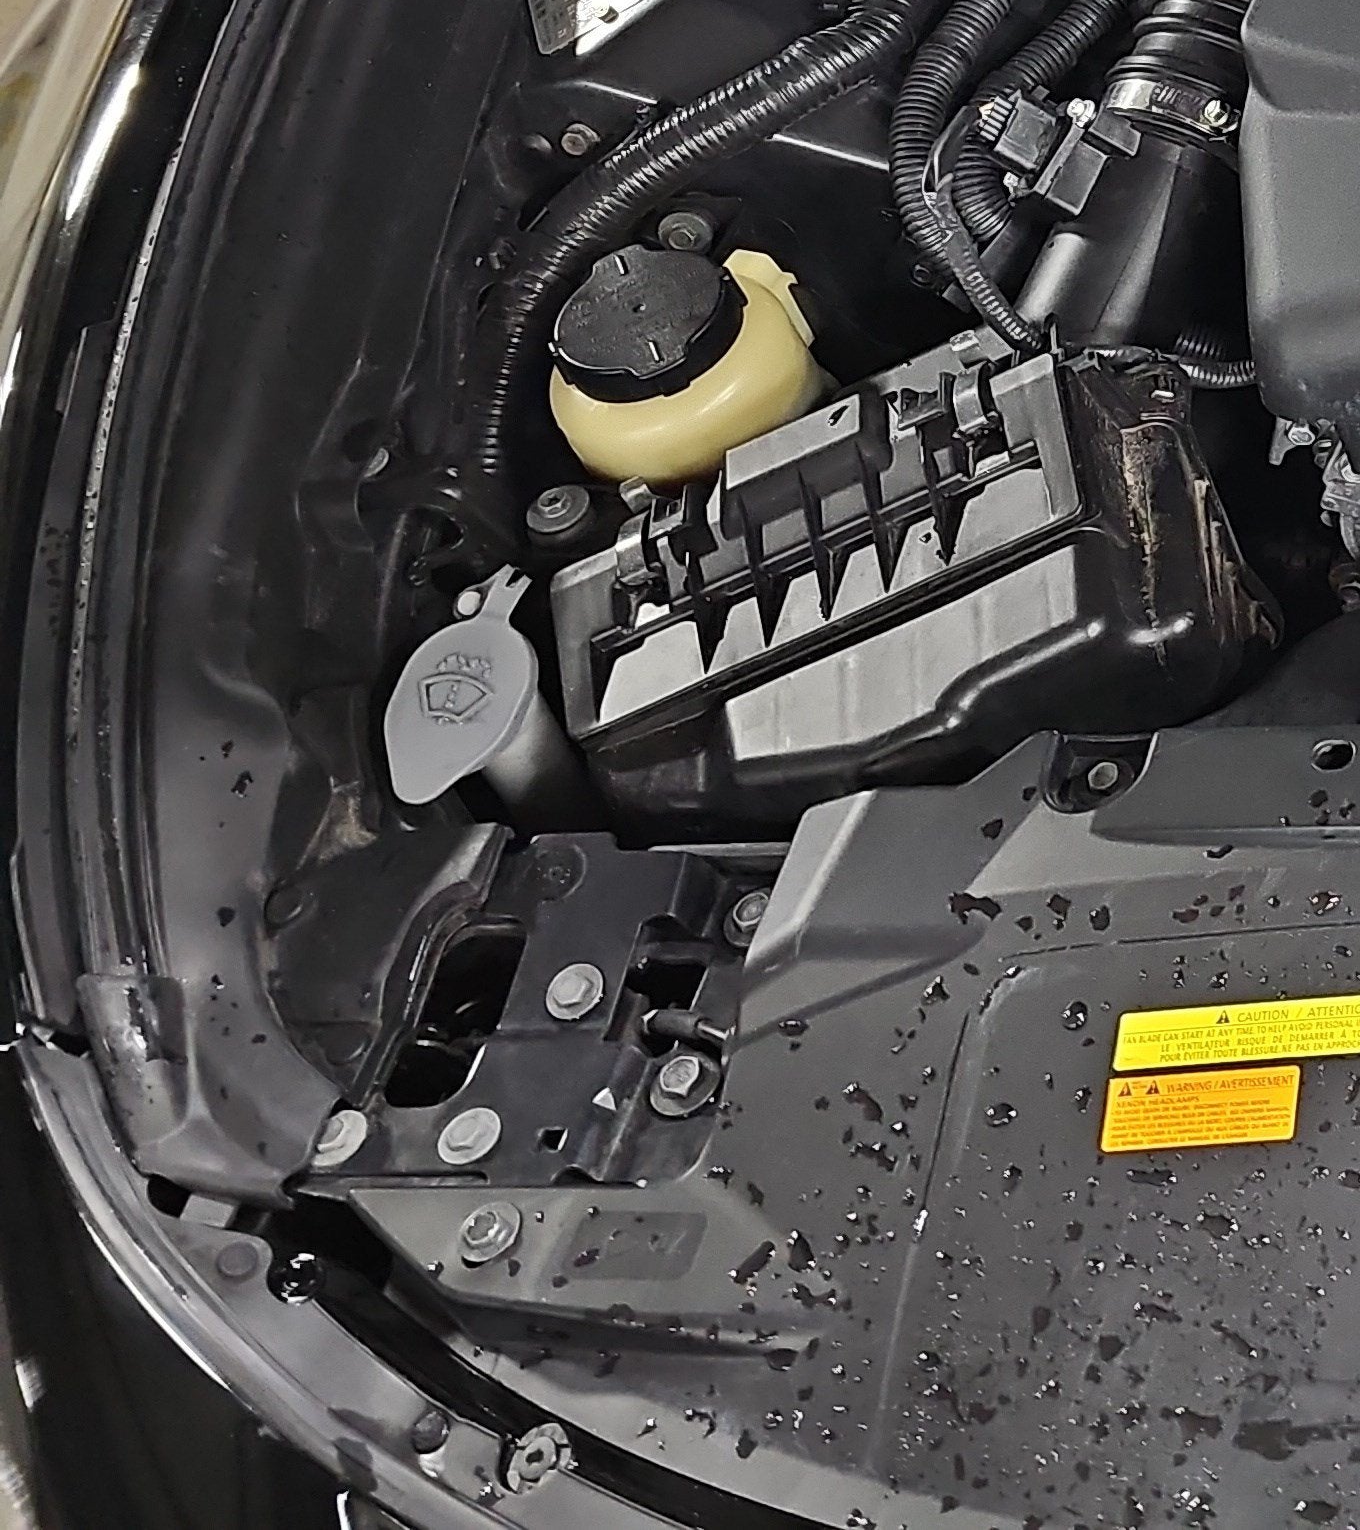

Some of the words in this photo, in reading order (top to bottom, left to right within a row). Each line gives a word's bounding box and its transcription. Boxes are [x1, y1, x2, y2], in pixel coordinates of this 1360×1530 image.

[1238, 1009, 1289, 1022] CAUTION
[1163, 1032, 1179, 1041] CAN
[1181, 1031, 1204, 1040] START
[1206, 1030, 1215, 1038] AT
[1217, 1029, 1233, 1037] ANY
[1257, 1026, 1267, 1034] TO
[1268, 1024, 1287, 1033] HELP
[1288, 1022, 1313, 1031] AVOID
[1316, 1020, 1353, 1030] PERSONAL
[1160, 1052, 1180, 1062] POUR
[1213, 1048, 1238, 1058] TOUTE
[1295, 1043, 1310, 1052] PAS
[1313, 1042, 1323, 1051] EN
[1161, 1044, 1170, 1053] LE
[1177, 1039, 1230, 1051] VENTILATEUR
[1237, 1037, 1266, 1046] RISQUE
[1272, 1034, 1283, 1043] DE
[1166, 1080, 1212, 1093] WARNING
[1220, 1075, 1295, 1089] AVERTISSEMENT
